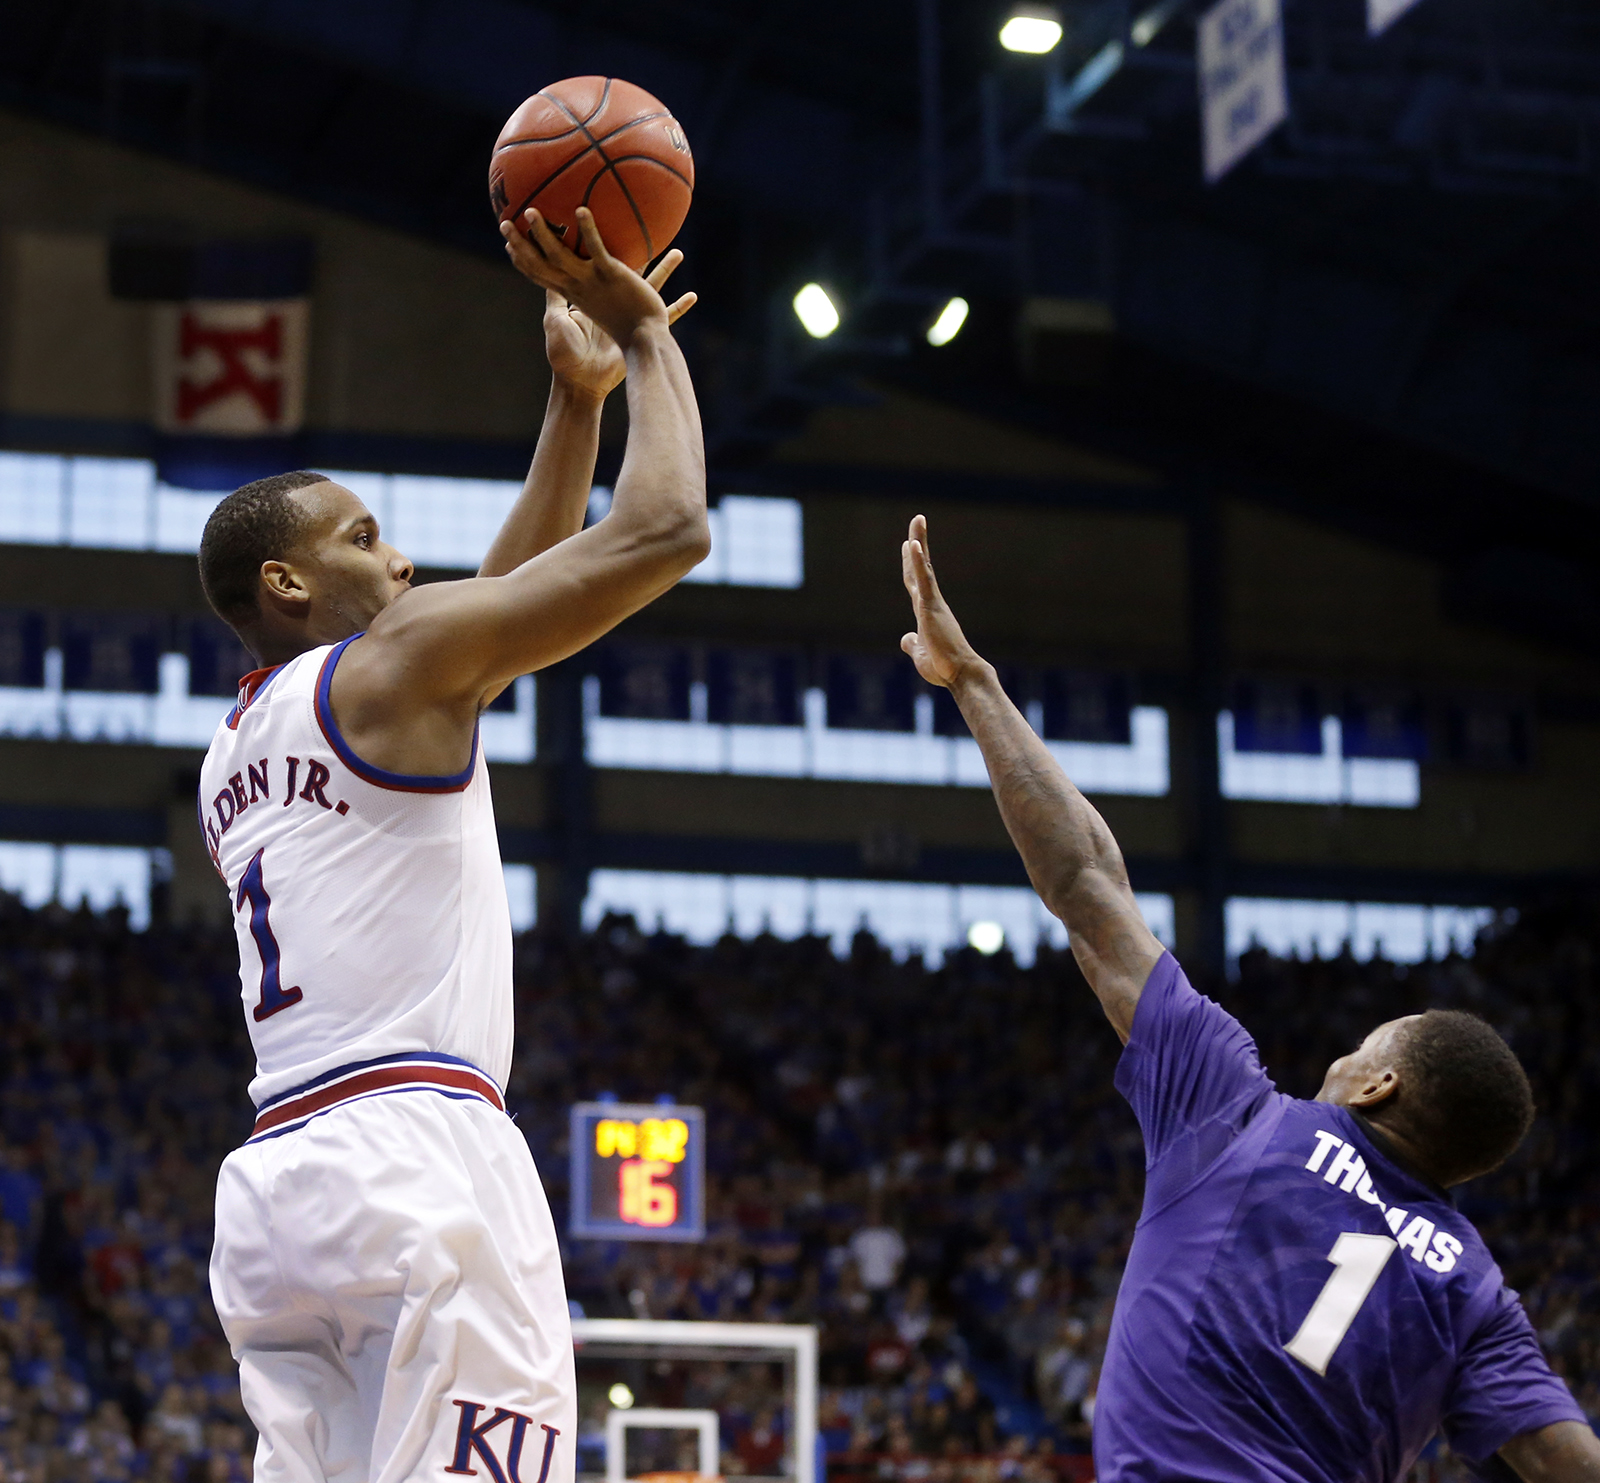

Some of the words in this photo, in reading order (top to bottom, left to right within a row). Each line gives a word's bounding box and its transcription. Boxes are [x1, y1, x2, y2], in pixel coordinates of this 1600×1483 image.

[177, 314, 284, 424] K
[206, 758, 269, 884] LDEN
[284, 756, 350, 816] JR.
[237, 847, 304, 1022] 1
[619, 1158, 678, 1228] 16
[1282, 1231, 1399, 1377] 1
[444, 1399, 561, 1483] KU
